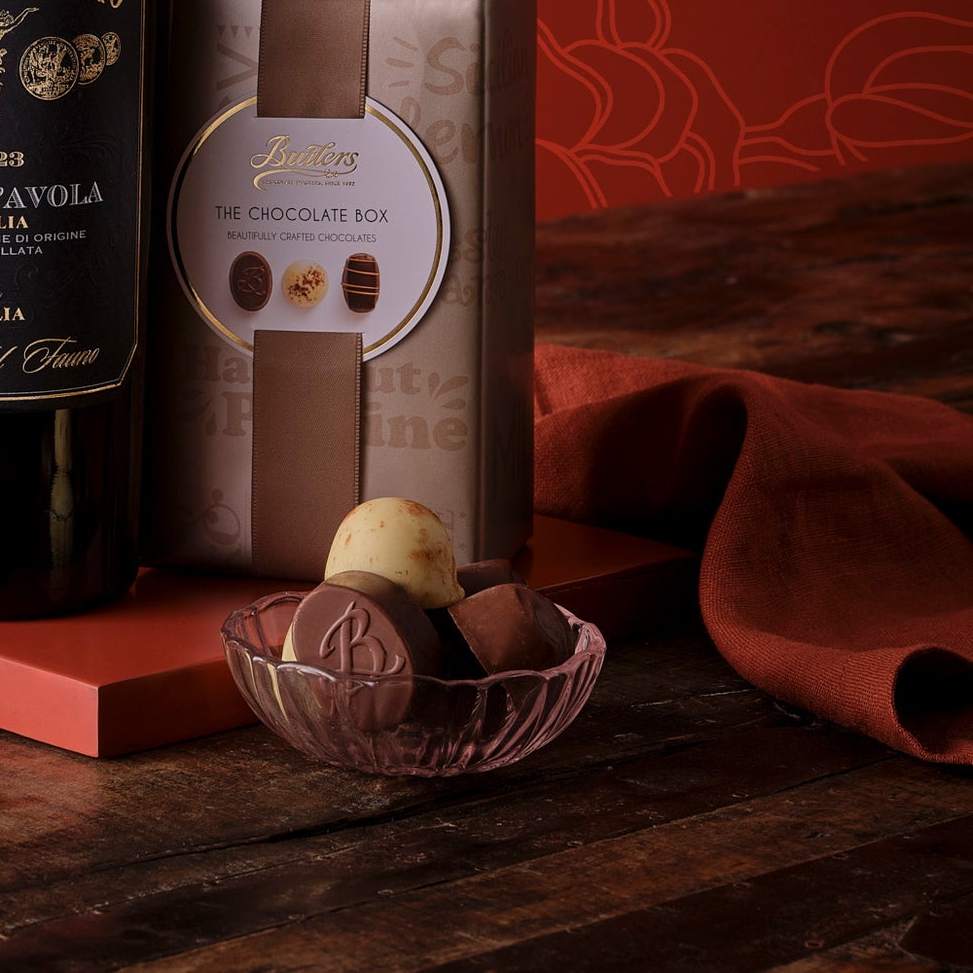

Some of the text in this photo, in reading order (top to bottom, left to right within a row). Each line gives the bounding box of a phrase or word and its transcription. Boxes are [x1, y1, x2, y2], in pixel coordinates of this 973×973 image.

[250, 133, 359, 171] Butlers
[215, 205, 389, 223] THE CHOCOLATE BOX
[15, 233, 29, 244] DI
[33, 229, 87, 242] ORIGINE
[227, 231, 377, 243] BEAUTIFULLY CRAFTED CHOCOLATES
[22, 335, 101, 374] Fauno
